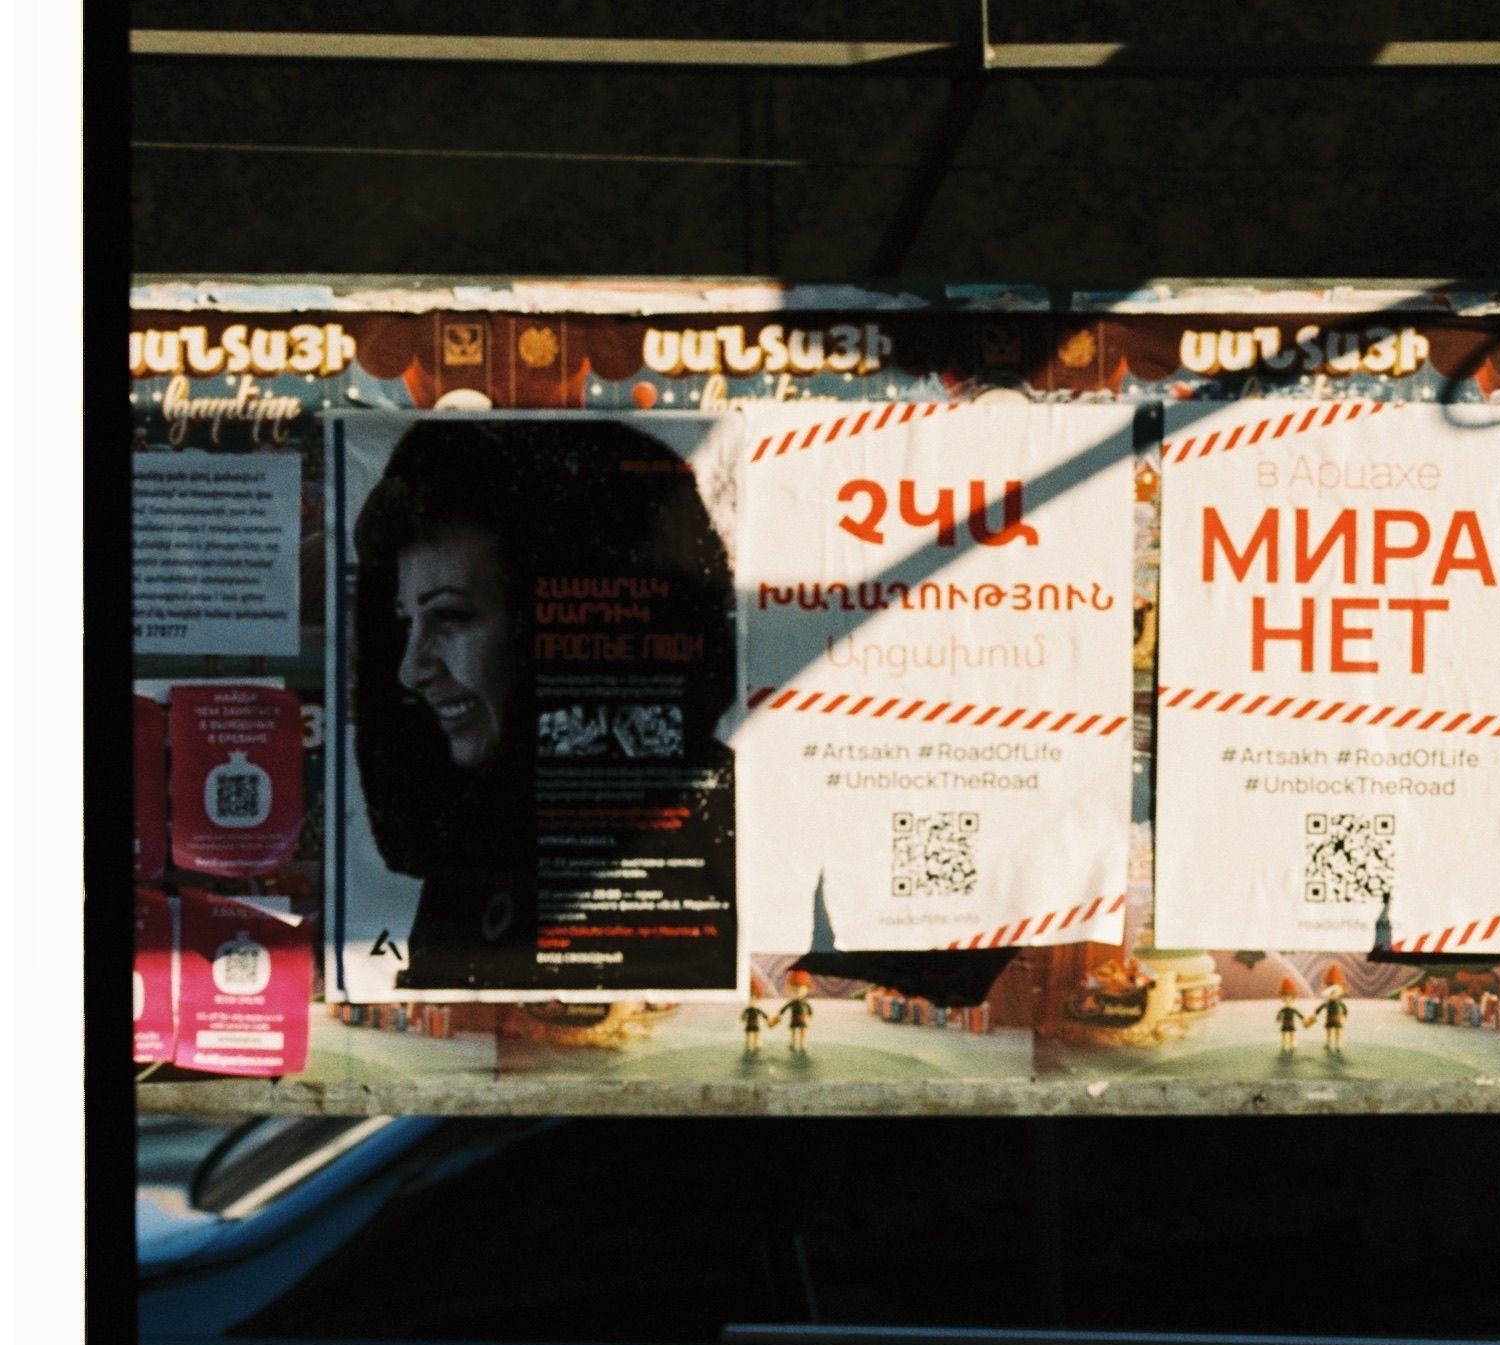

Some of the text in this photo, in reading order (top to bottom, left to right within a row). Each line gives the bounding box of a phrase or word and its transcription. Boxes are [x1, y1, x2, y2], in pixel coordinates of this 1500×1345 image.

[643, 324, 892, 373] ՍԱՆՏԱՅԻ
[1180, 325, 1429, 374] ՍԱՆՏԱՅԻ
[1256, 455, 1442, 496] в Арцахе
[836, 478, 1040, 547] ՉԿԱ
[1202, 507, 1498, 587] МИРА
[757, 580, 1115, 612] ԽԱՂԱՂՈՒԹՅՈՒՆ
[826, 633, 1048, 674] Արցախում
[1251, 596, 1450, 674] НЕТ
[803, 742, 1064, 762] #Artsakh #RoadOfLife
[1222, 747, 1480, 768] #Artsakh #RoadOfLife
[826, 771, 1040, 790] #UnblockTheRoad
[1244, 776, 1456, 796] #UnblockTheRoad
